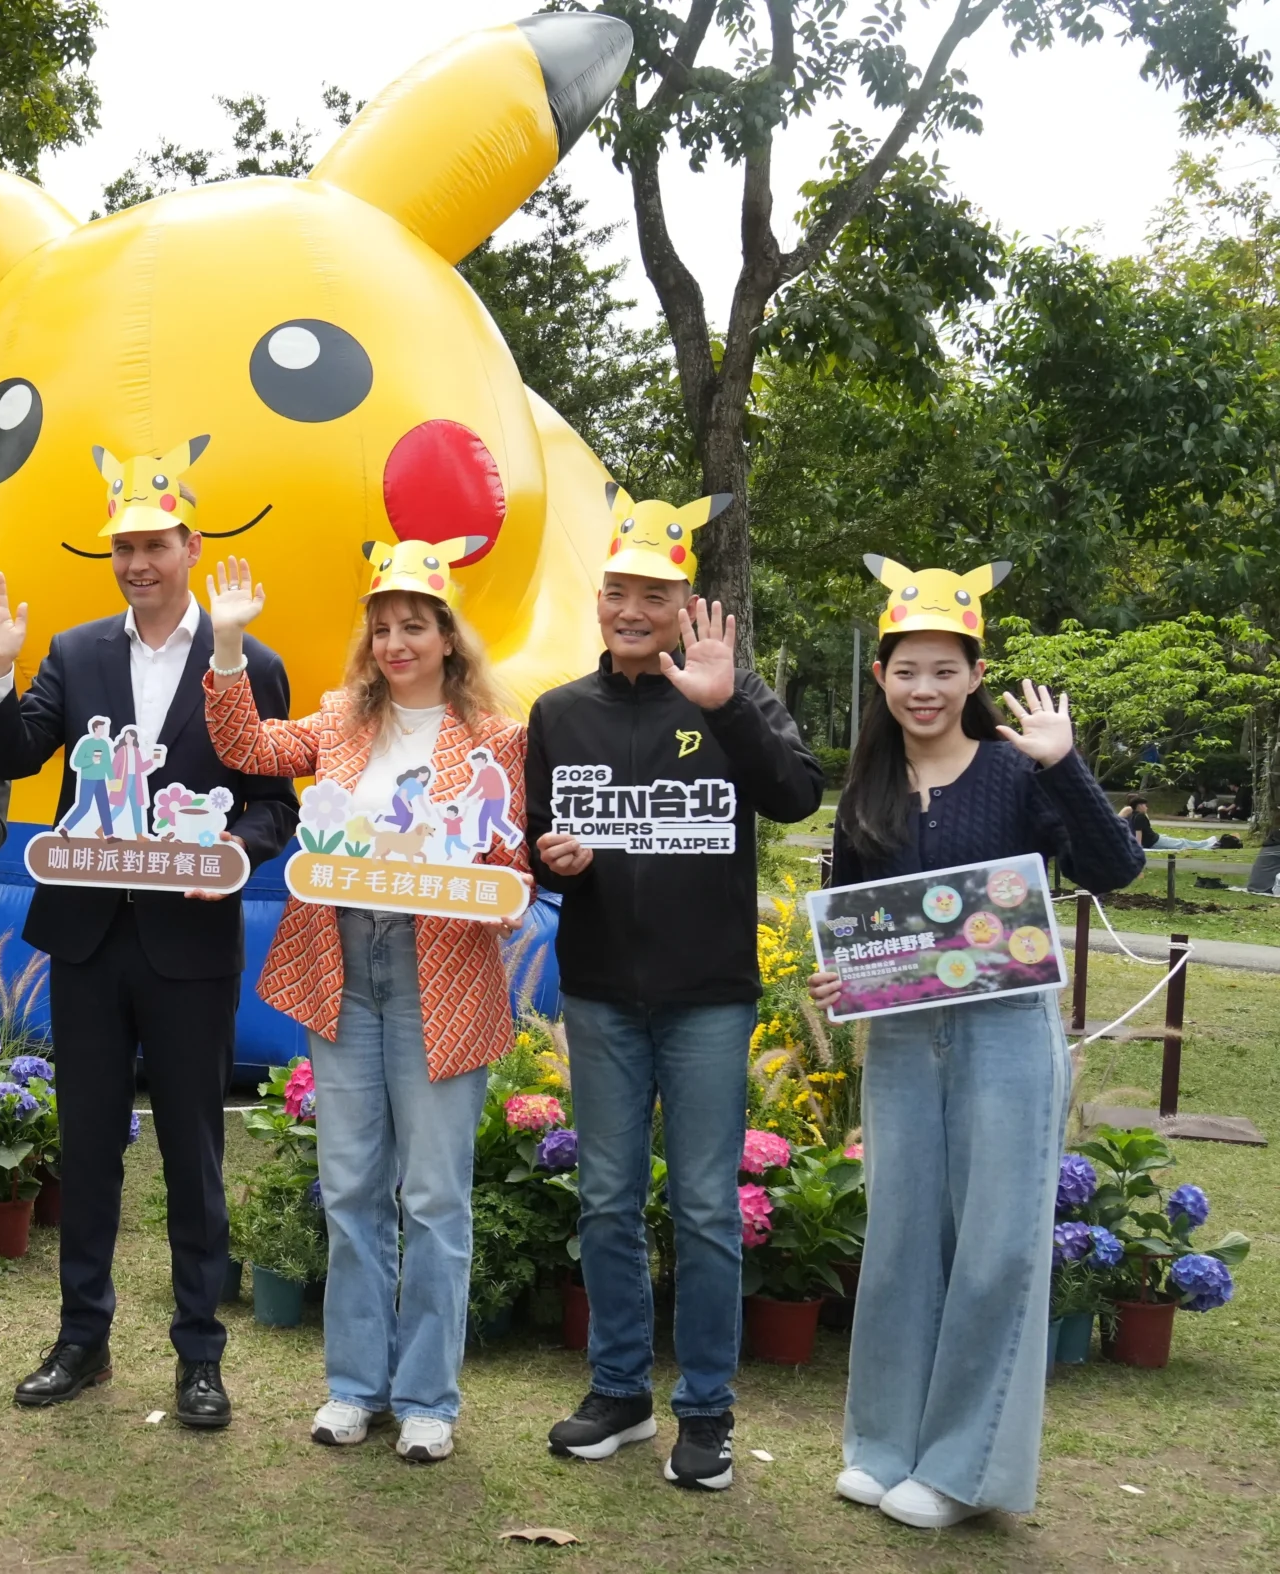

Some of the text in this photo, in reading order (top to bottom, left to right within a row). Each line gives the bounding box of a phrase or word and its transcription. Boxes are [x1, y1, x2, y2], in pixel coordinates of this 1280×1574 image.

[556, 769, 607, 782] 2026
[555, 783, 731, 819] 花IN台北
[556, 822, 653, 836] FLOWERS
[630, 837, 730, 850] IN TAIPEI
[48, 846, 222, 878] 咖啡派對野餐區
[309, 862, 499, 906] 親子毛孩野餐區
[833, 931, 936, 963] 台北花伴野餐
